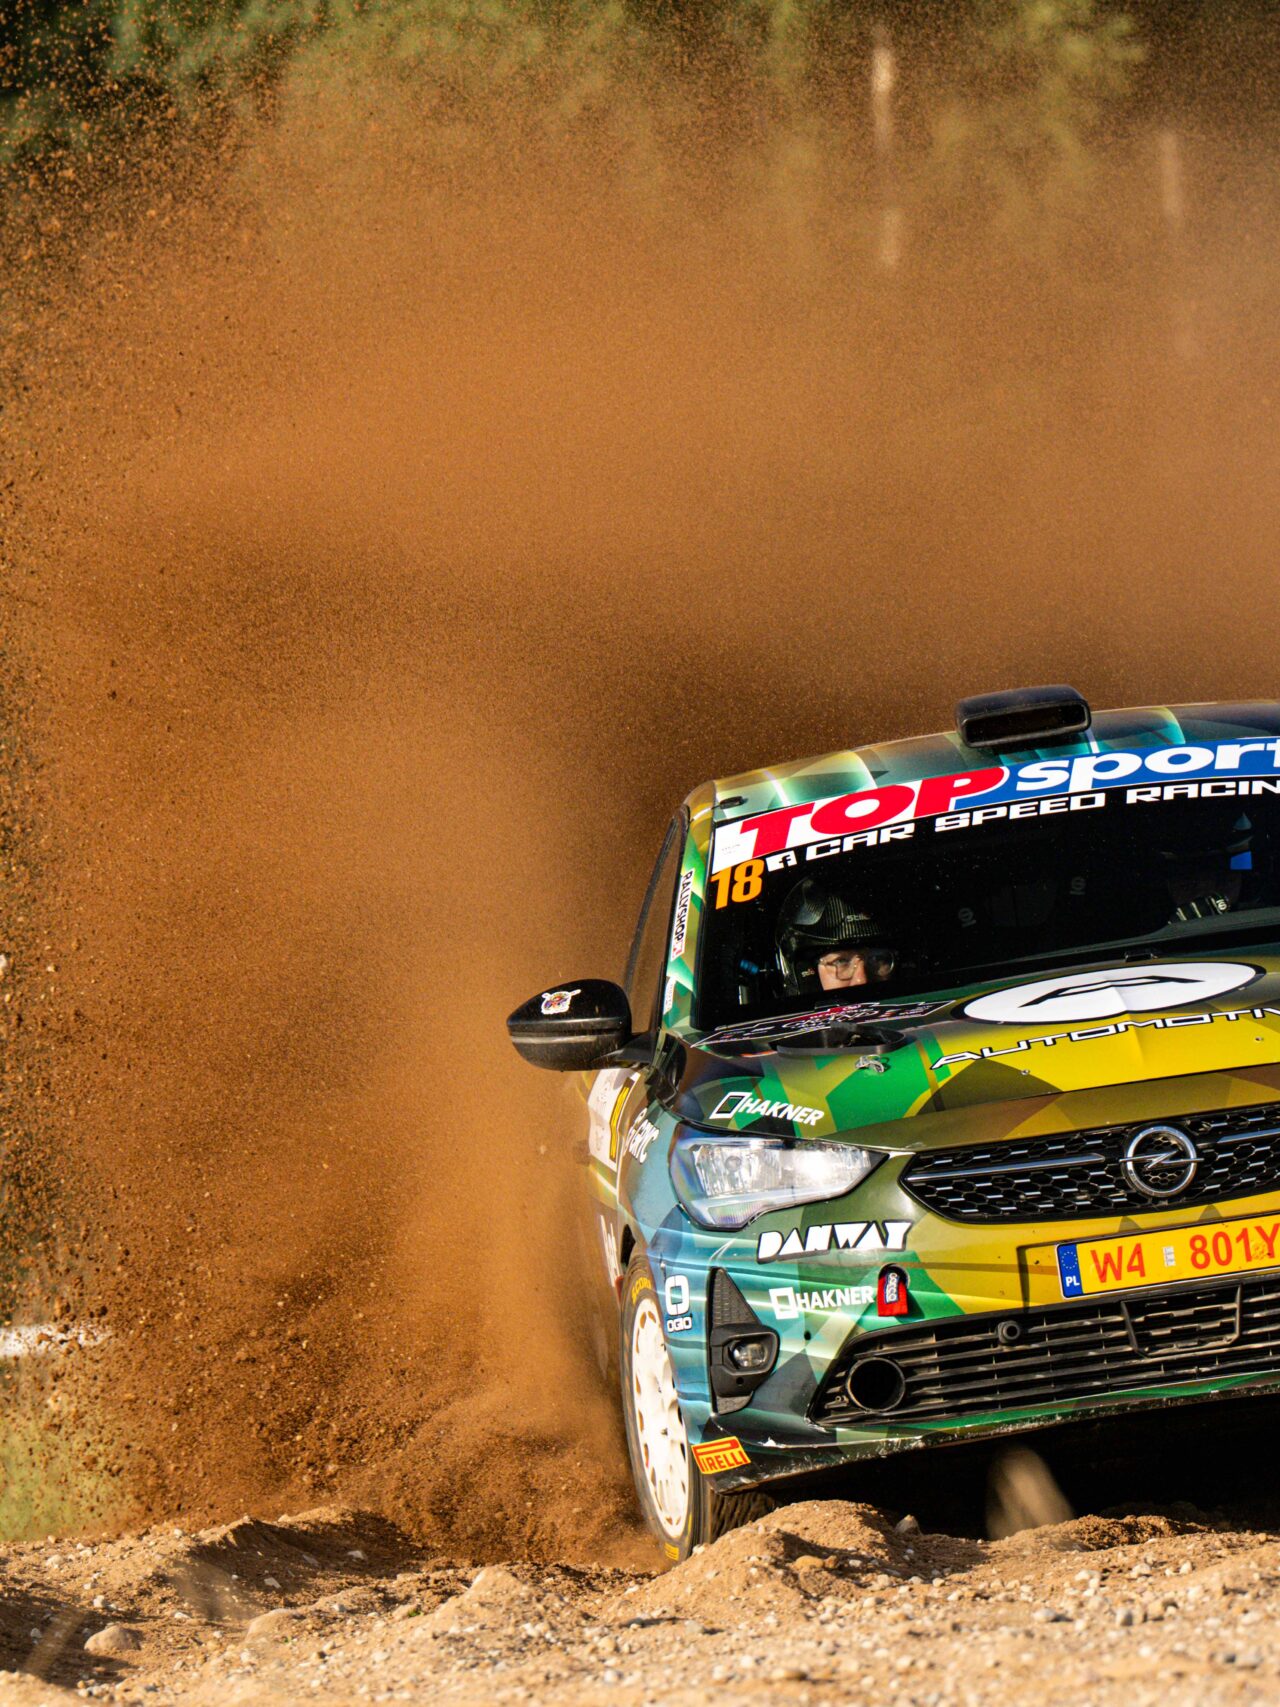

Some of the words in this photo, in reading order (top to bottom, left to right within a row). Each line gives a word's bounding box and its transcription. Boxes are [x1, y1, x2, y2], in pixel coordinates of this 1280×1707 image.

[805, 822, 916, 861] CAR
[934, 792, 1106, 832] SPEED
[674, 869, 693, 942] RALLYSHOP
[710, 858, 765, 910] 18
[738, 1095, 825, 1127] HAKNER
[757, 1221, 913, 1262] DANWAY
[1065, 1275, 1080, 1288] PL
[1091, 1242, 1146, 1284] W4
[1189, 1222, 1280, 1270] 801Y
[798, 1285, 875, 1313] HAKNER
[692, 1438, 749, 1472] PIRELLI
